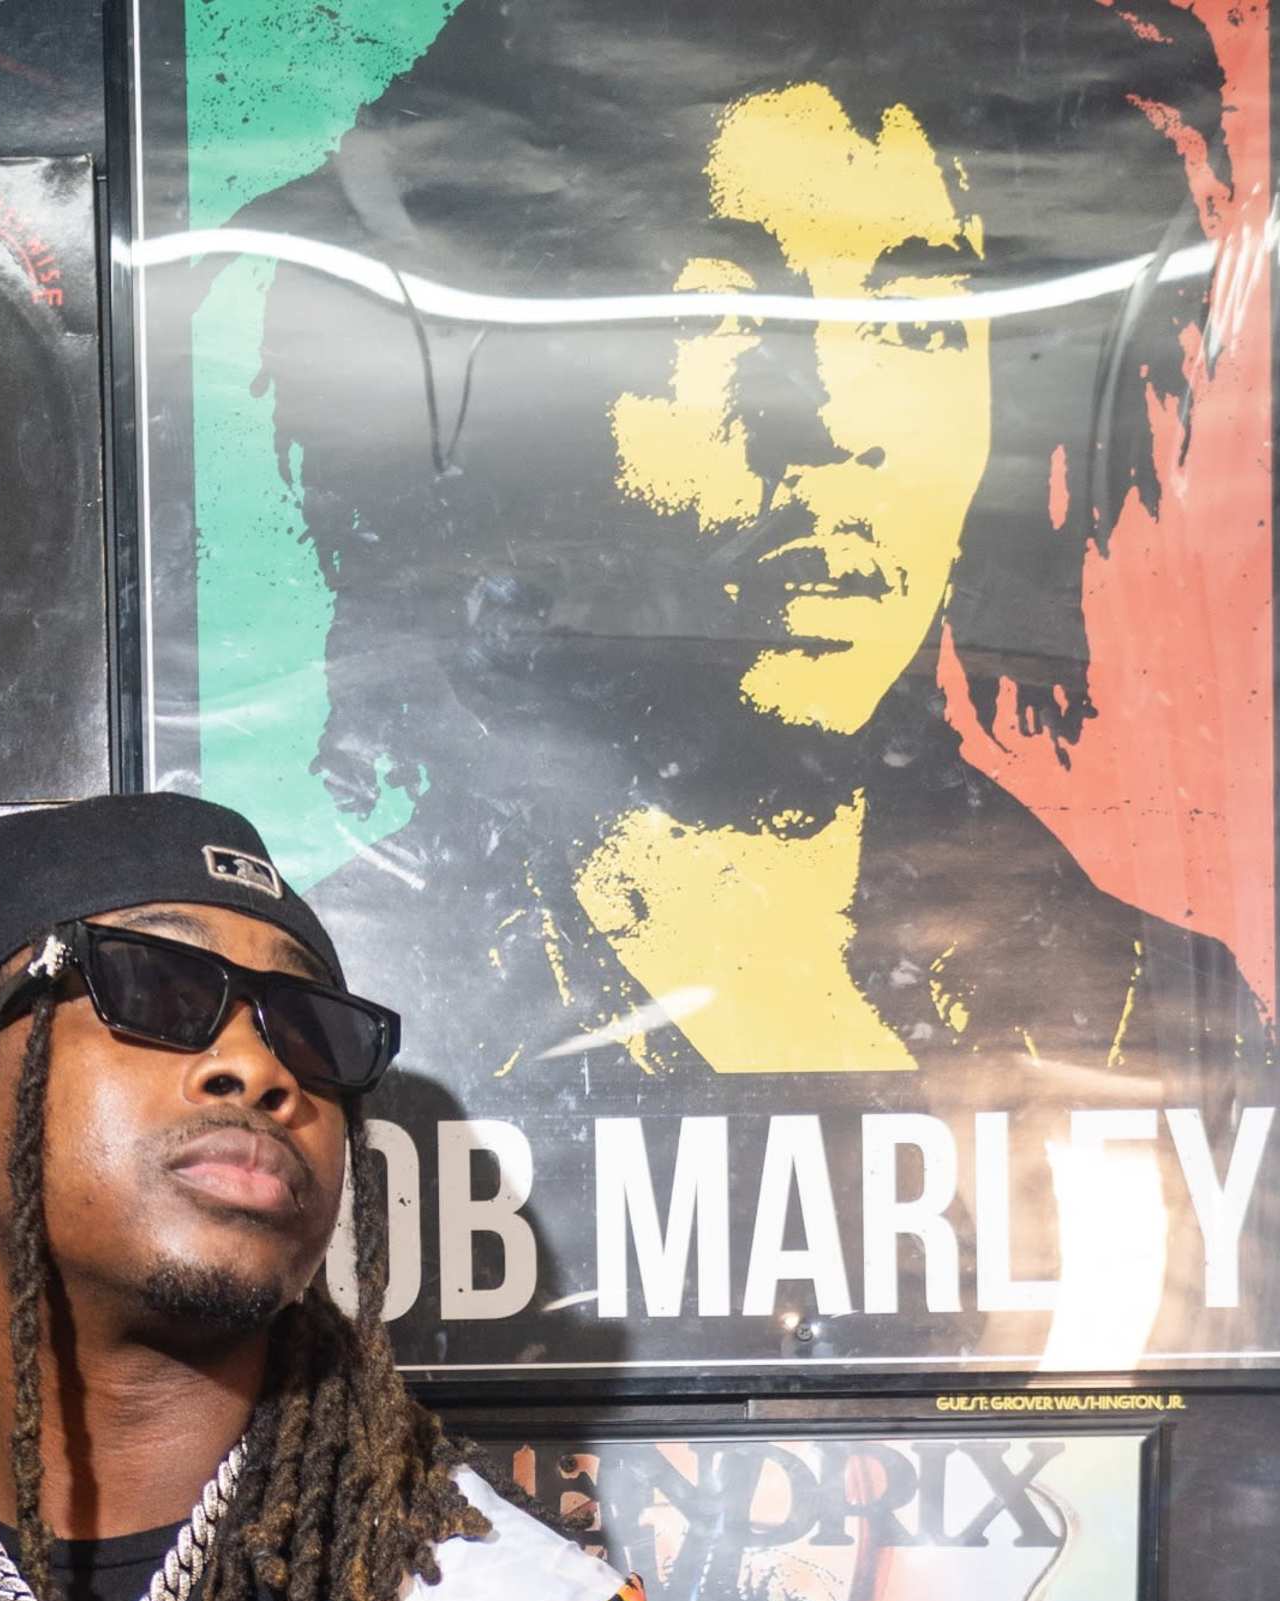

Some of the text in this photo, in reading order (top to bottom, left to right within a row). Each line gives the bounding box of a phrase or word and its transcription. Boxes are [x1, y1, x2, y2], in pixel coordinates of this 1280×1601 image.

[324, 1119, 538, 1325] OB
[593, 1106, 1276, 1319] MARLY
[935, 1394, 1187, 1412] GUEST: GROVER WASHINGTON, JR.
[517, 1441, 1066, 1552] ENDRIX
